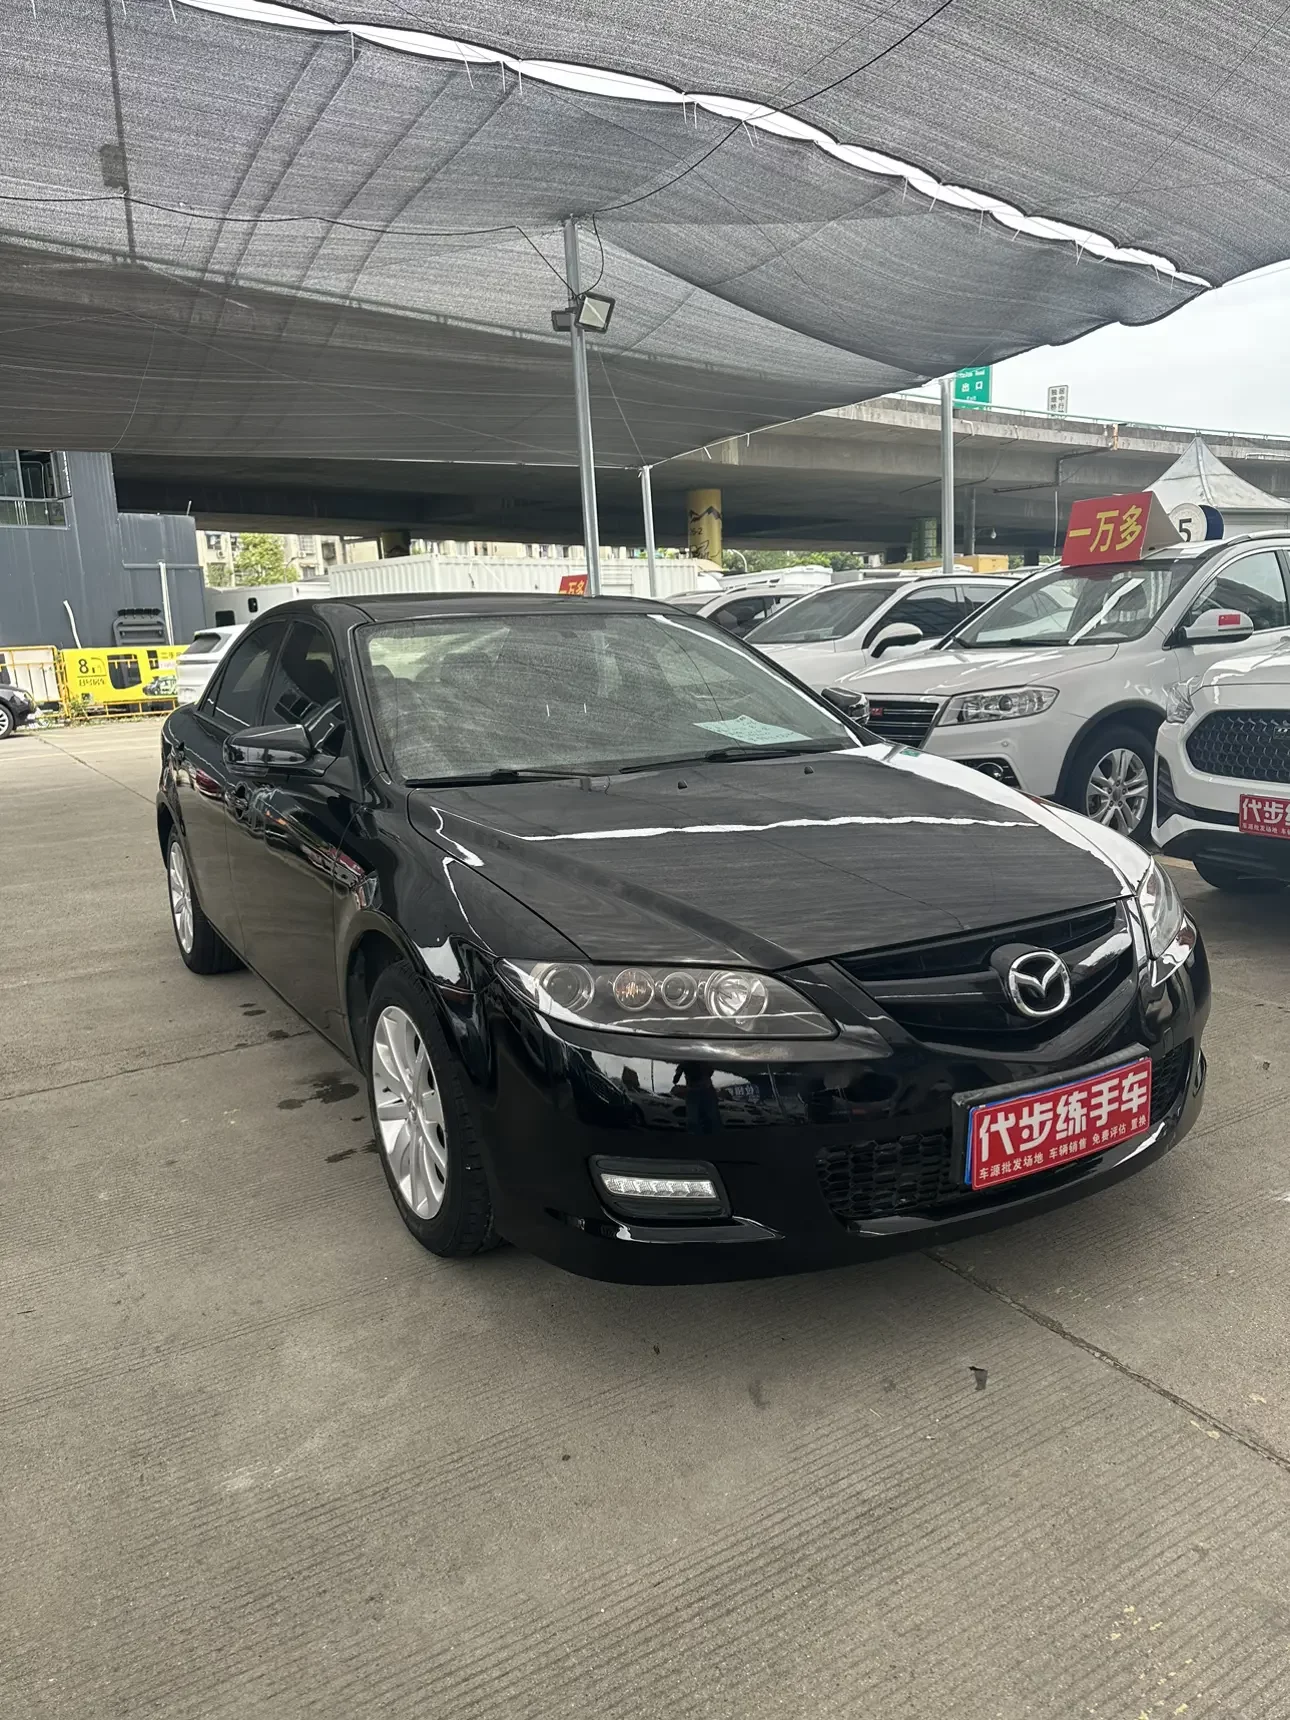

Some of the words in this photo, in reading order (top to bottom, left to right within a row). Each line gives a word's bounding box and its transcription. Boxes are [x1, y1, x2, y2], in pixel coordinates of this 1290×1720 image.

[1069, 504, 1143, 553] 一万多
[1178, 517, 1193, 542] 5
[1242, 798, 1290, 826] 代步
[979, 1070, 1148, 1162] 代步练手车
[979, 1151, 1044, 1180] 车源批发场地
[1049, 1137, 1087, 1160] 车辆销售
[1092, 1123, 1127, 1145] 免费评估
[1130, 1114, 1147, 1131] 置换
